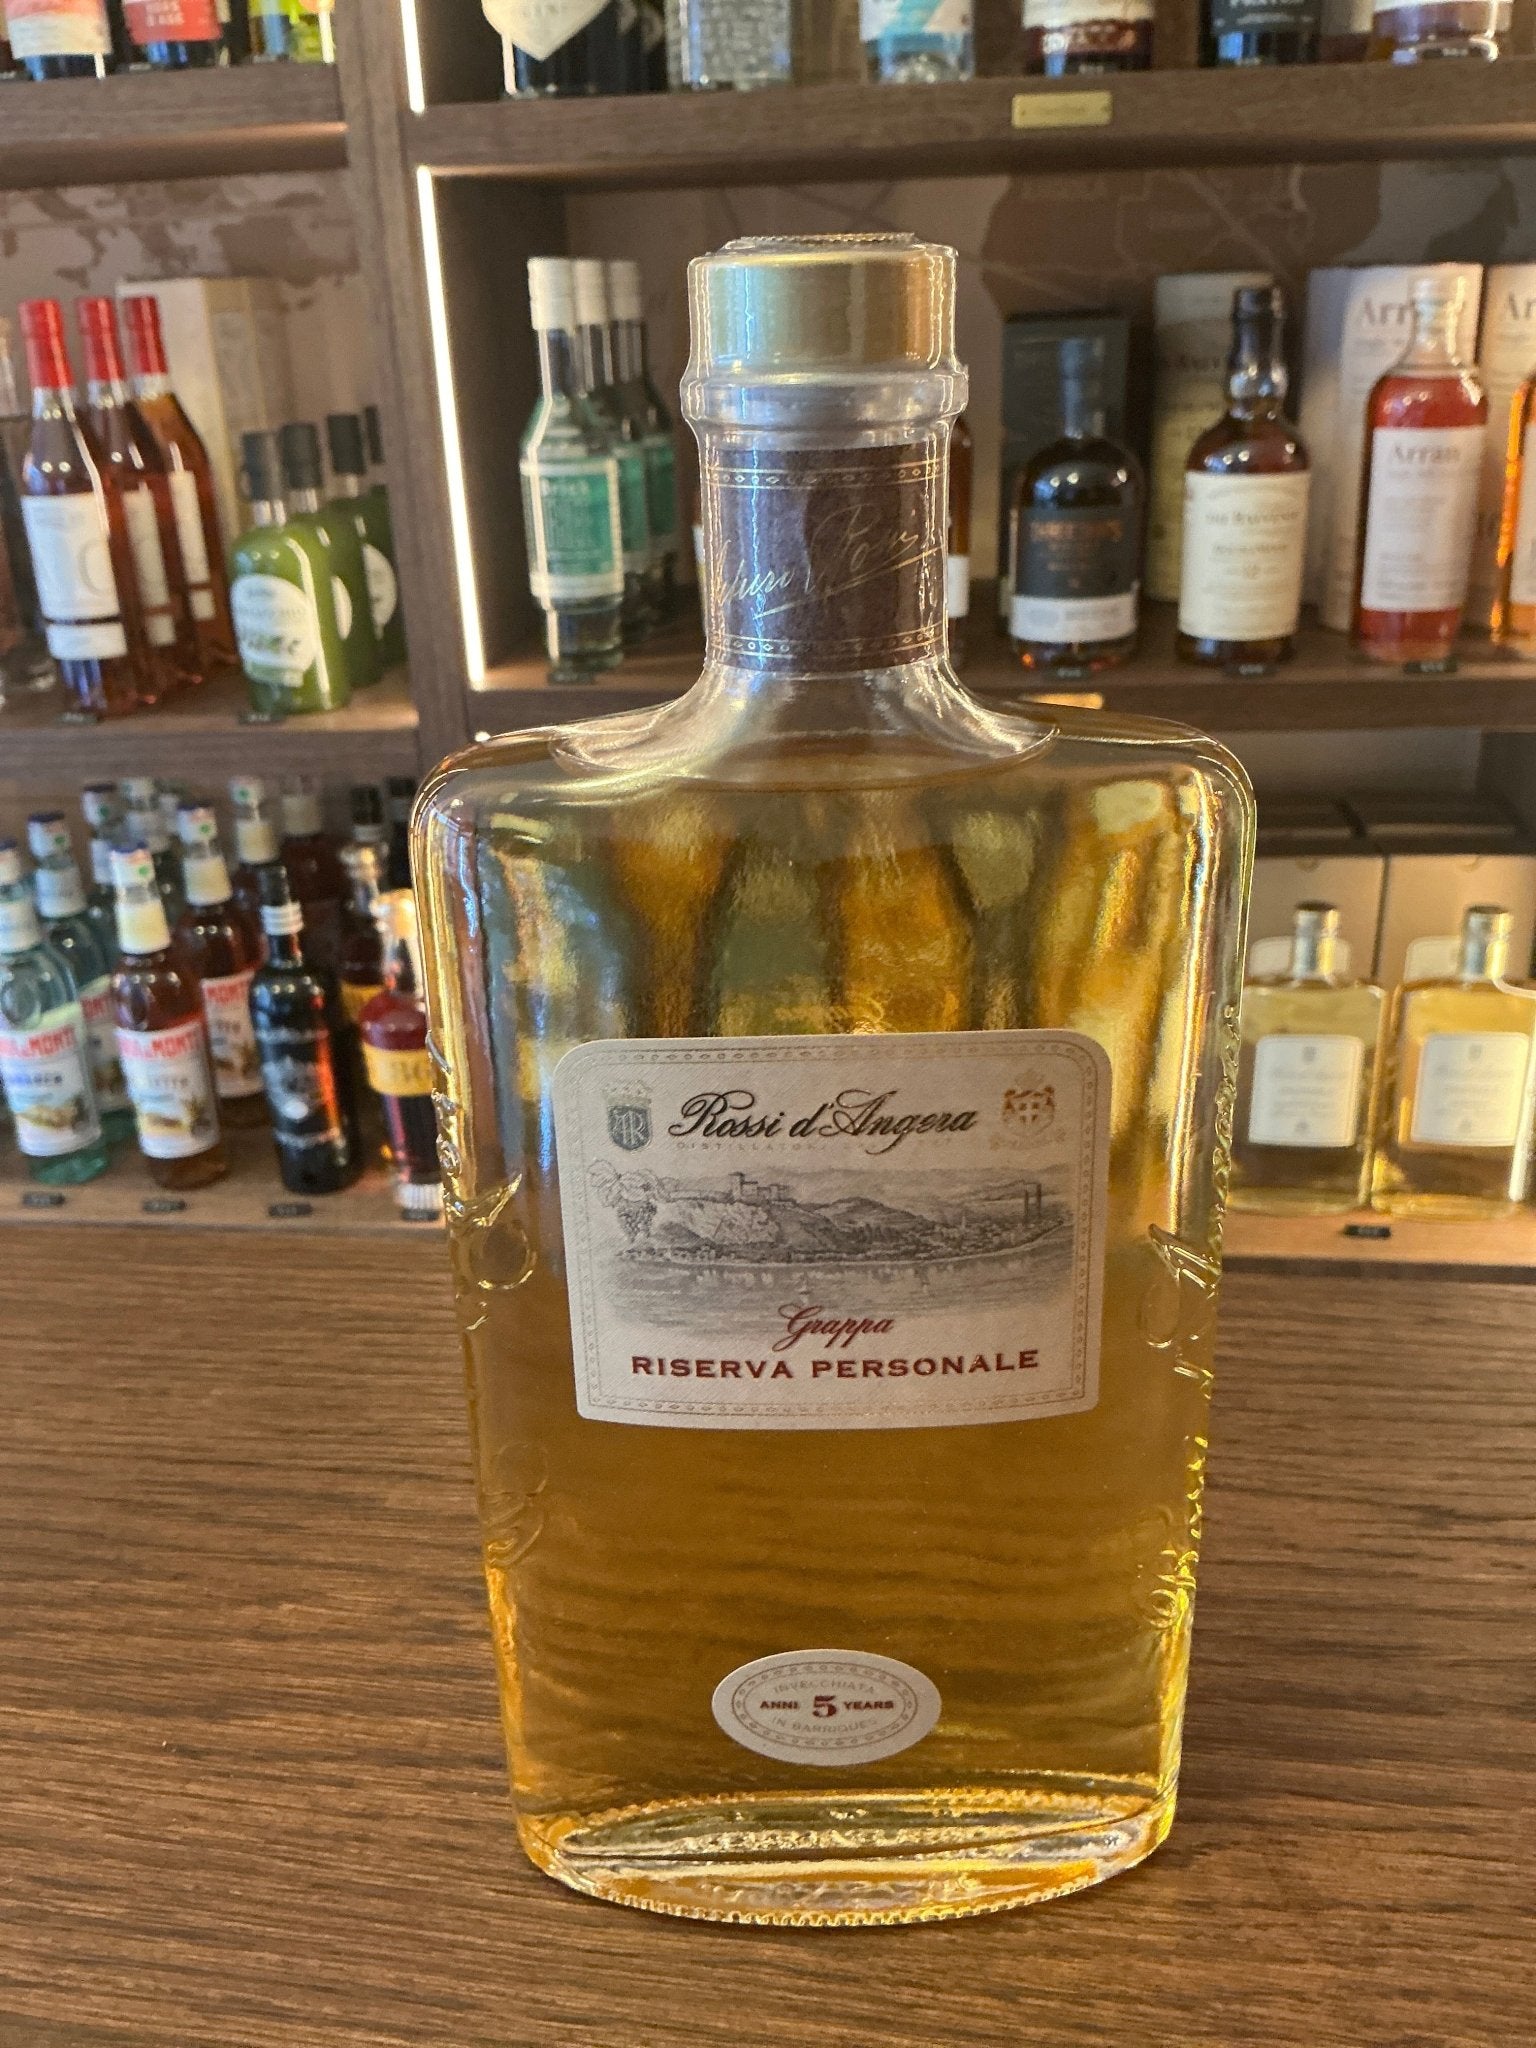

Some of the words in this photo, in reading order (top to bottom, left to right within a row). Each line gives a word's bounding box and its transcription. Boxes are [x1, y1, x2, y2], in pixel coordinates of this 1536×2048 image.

[668, 1089, 786, 1138] Rossi
[789, 1088, 979, 1156] d'Angera
[771, 1302, 895, 1353] Grappa
[631, 1355, 794, 1379] RISERVA
[811, 1349, 1039, 1379] PERSONALE
[773, 1679, 875, 1694] INVECCHIATA
[760, 1700, 799, 1710] ANNI
[812, 1694, 838, 1718] 5
[843, 1700, 895, 1710] YEARS
[792, 1716, 878, 1734] BARRIQUES
